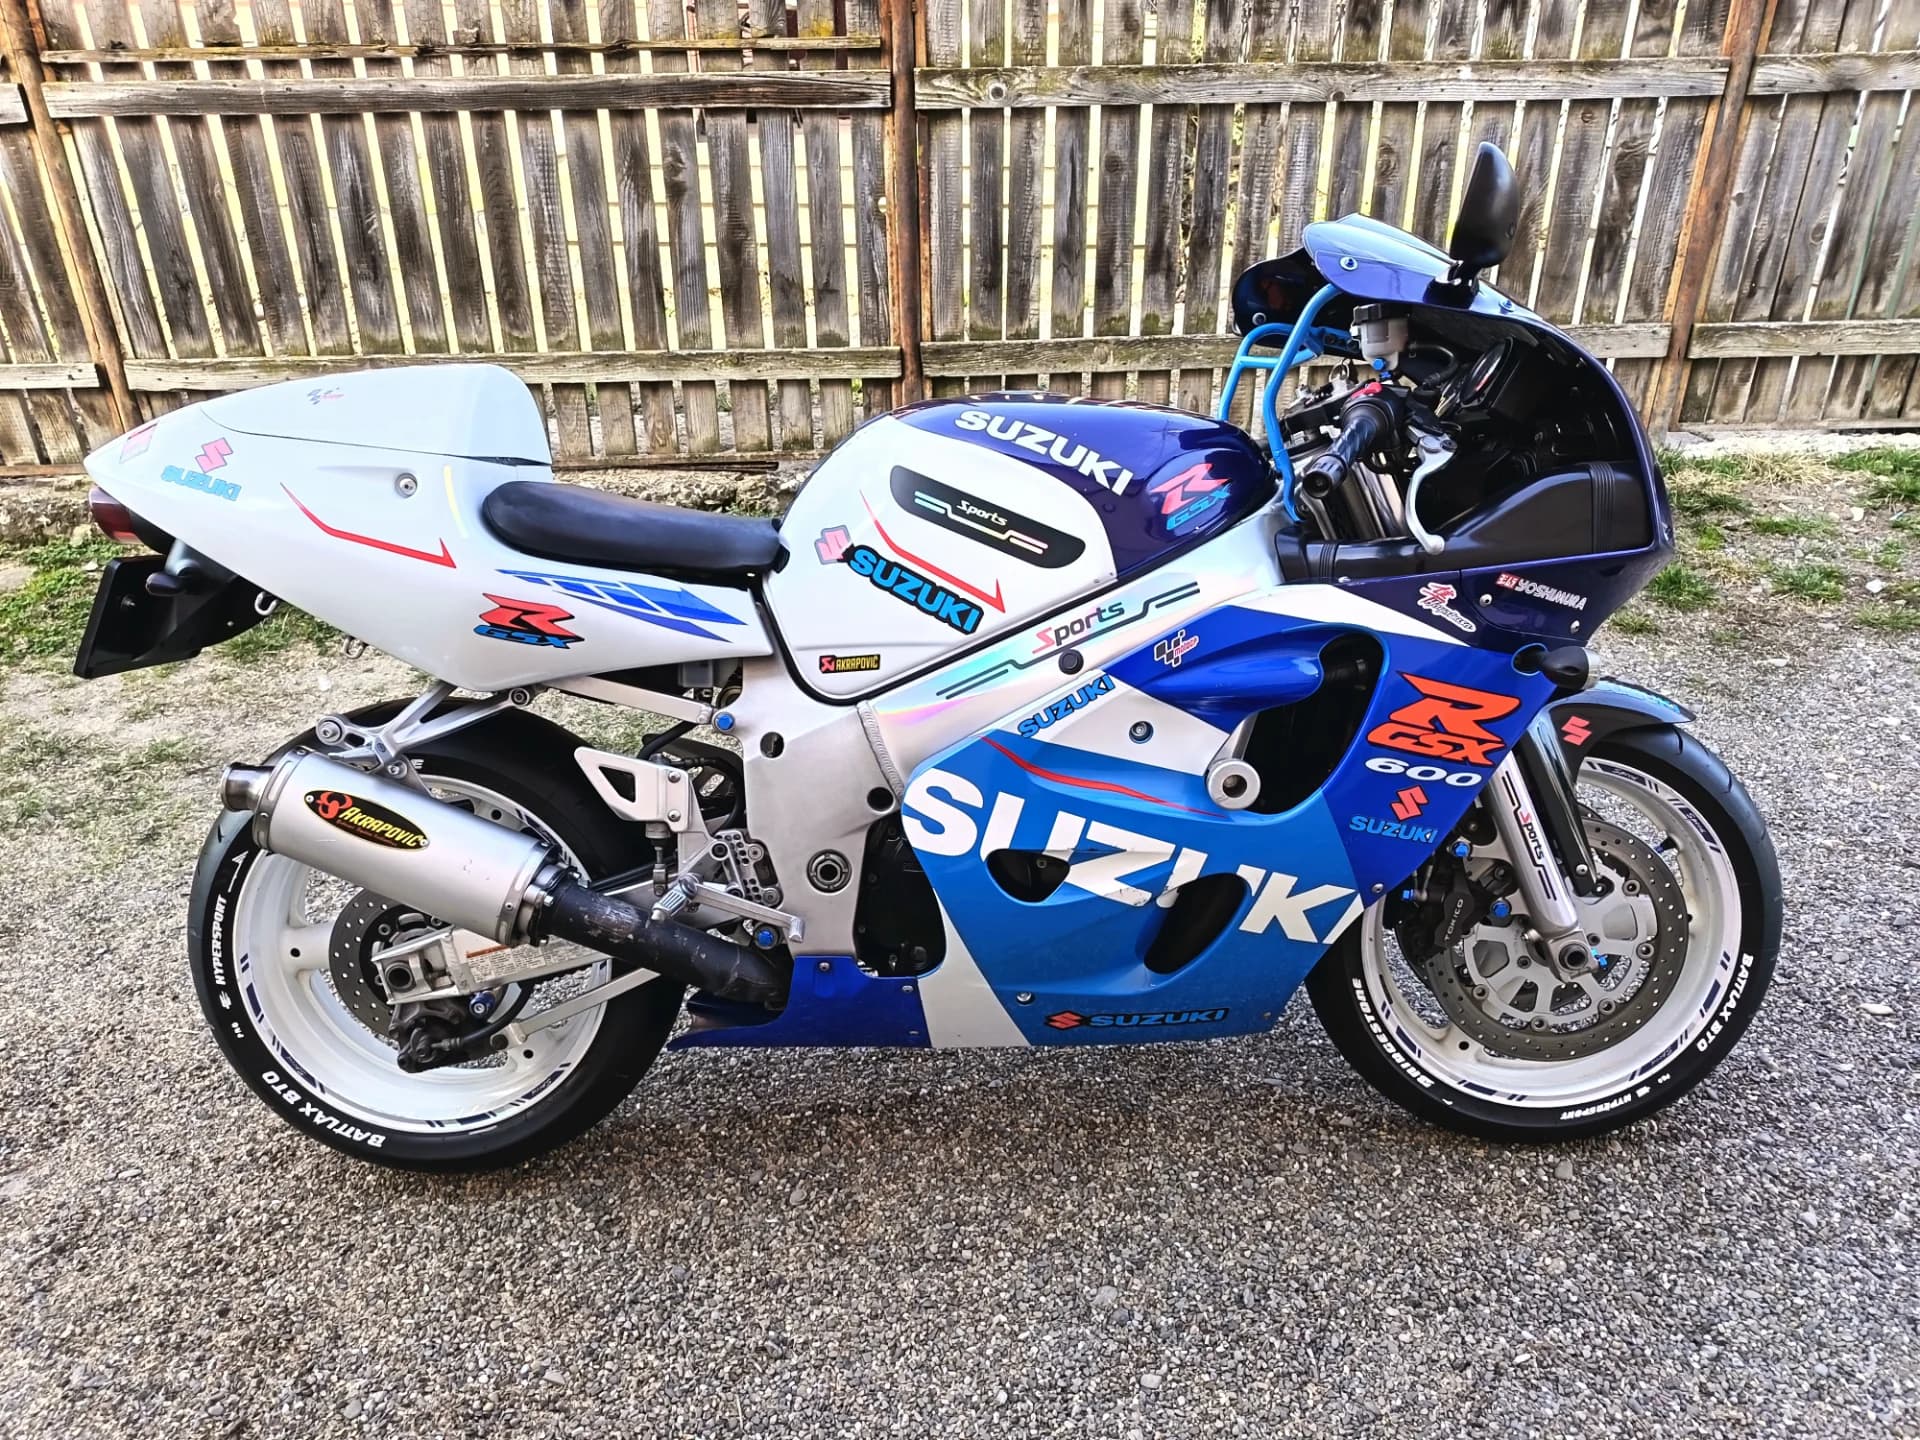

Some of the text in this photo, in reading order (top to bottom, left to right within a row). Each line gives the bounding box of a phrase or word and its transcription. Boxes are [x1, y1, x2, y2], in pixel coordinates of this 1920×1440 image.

[955, 410, 1134, 497] SUZUKI
[160, 465, 242, 501] SUZUKI
[1166, 483, 1232, 531] GSX
[956, 500, 1008, 526] Sports
[849, 547, 980, 633] SUZUKI
[473, 624, 577, 649] GSX
[1032, 602, 1125, 654] Sports
[835, 655, 880, 671] AKRAPOVIC
[1018, 673, 1116, 739] SUZUKI
[1389, 672, 1521, 742] R
[1367, 721, 1505, 767] GSX
[1365, 757, 1482, 787] 600
[1349, 815, 1439, 844] SUZUKI
[1519, 811, 1545, 860] Sports
[211, 893, 228, 986] HYPERSPORT
[1090, 1009, 1225, 1027] SUZUKI
[1351, 977, 1435, 1088] BRIDGESTONE
